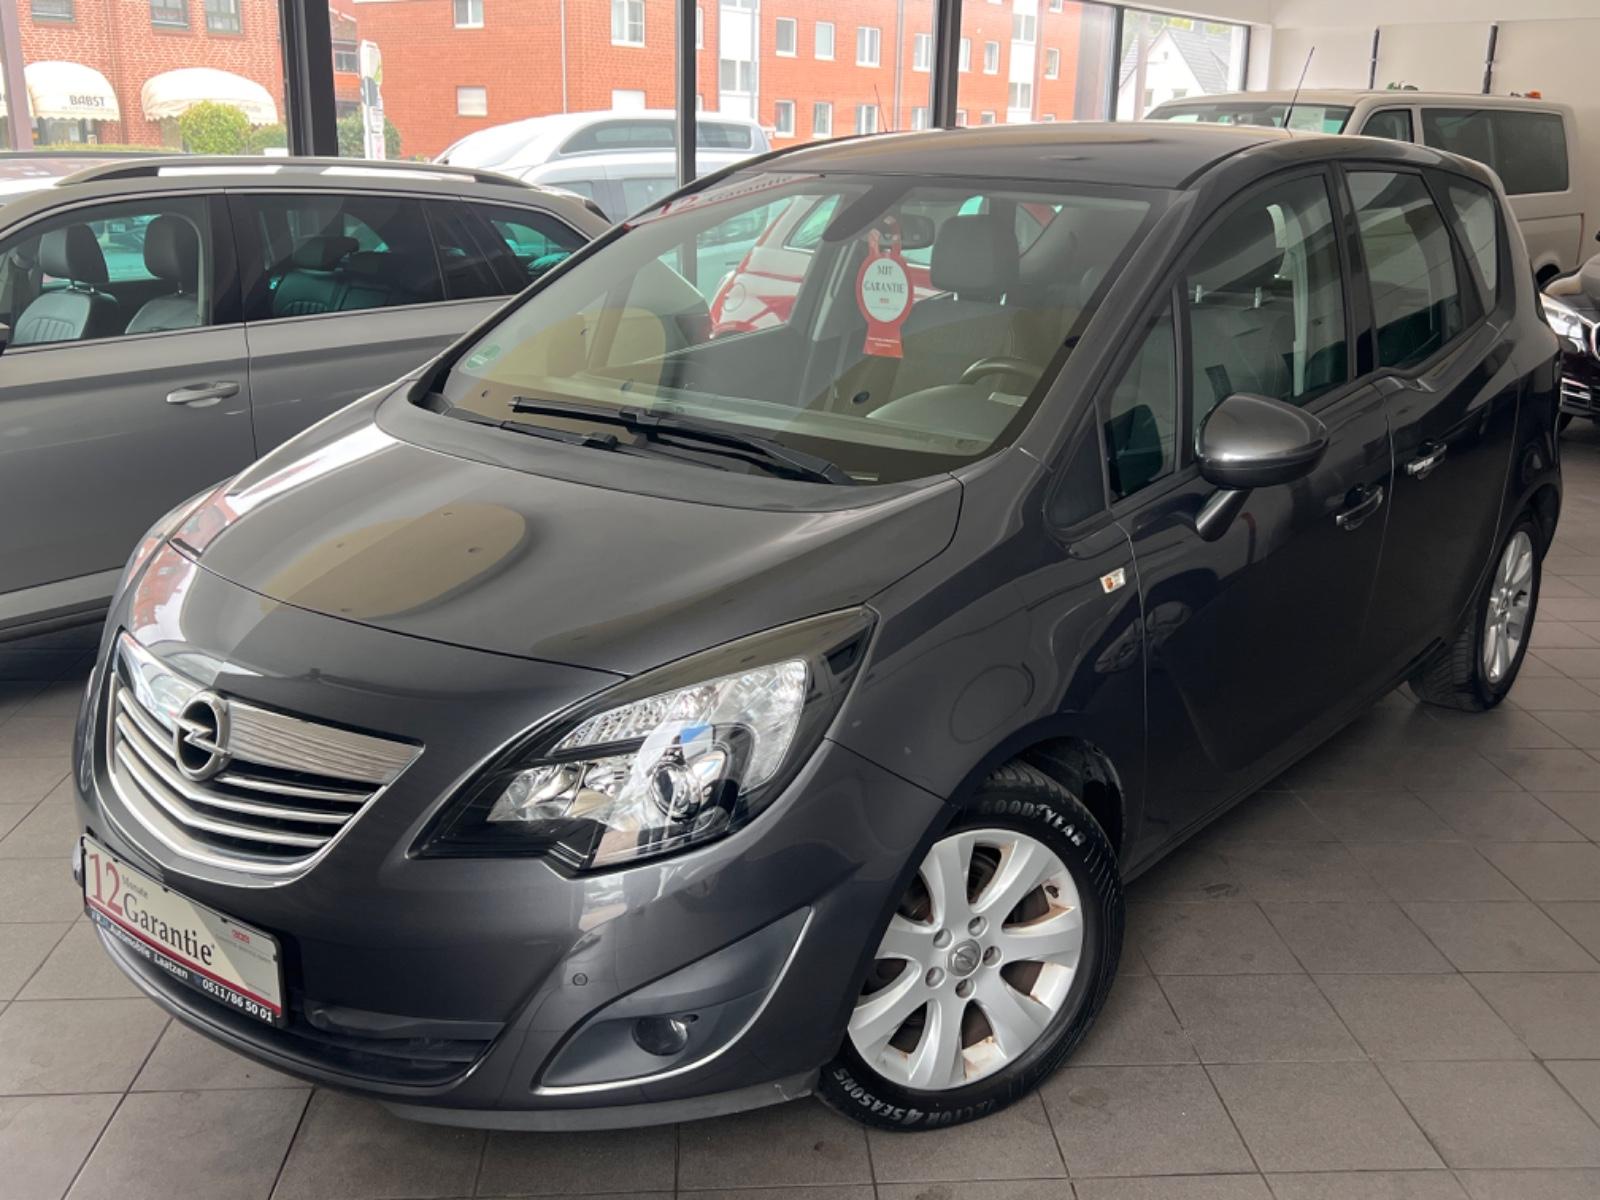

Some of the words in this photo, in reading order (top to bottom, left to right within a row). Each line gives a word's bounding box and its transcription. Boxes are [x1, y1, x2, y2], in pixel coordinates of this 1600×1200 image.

[863, 281, 905, 295] GARANTIE
[877, 265, 894, 277] MIT
[89, 852, 123, 917] 12
[123, 892, 213, 967] Garantie
[154, 953, 189, 980] Laatzen
[202, 978, 244, 1008] 0511/86
[245, 1000, 259, 1015] 50
[260, 1008, 273, 1022] 01
